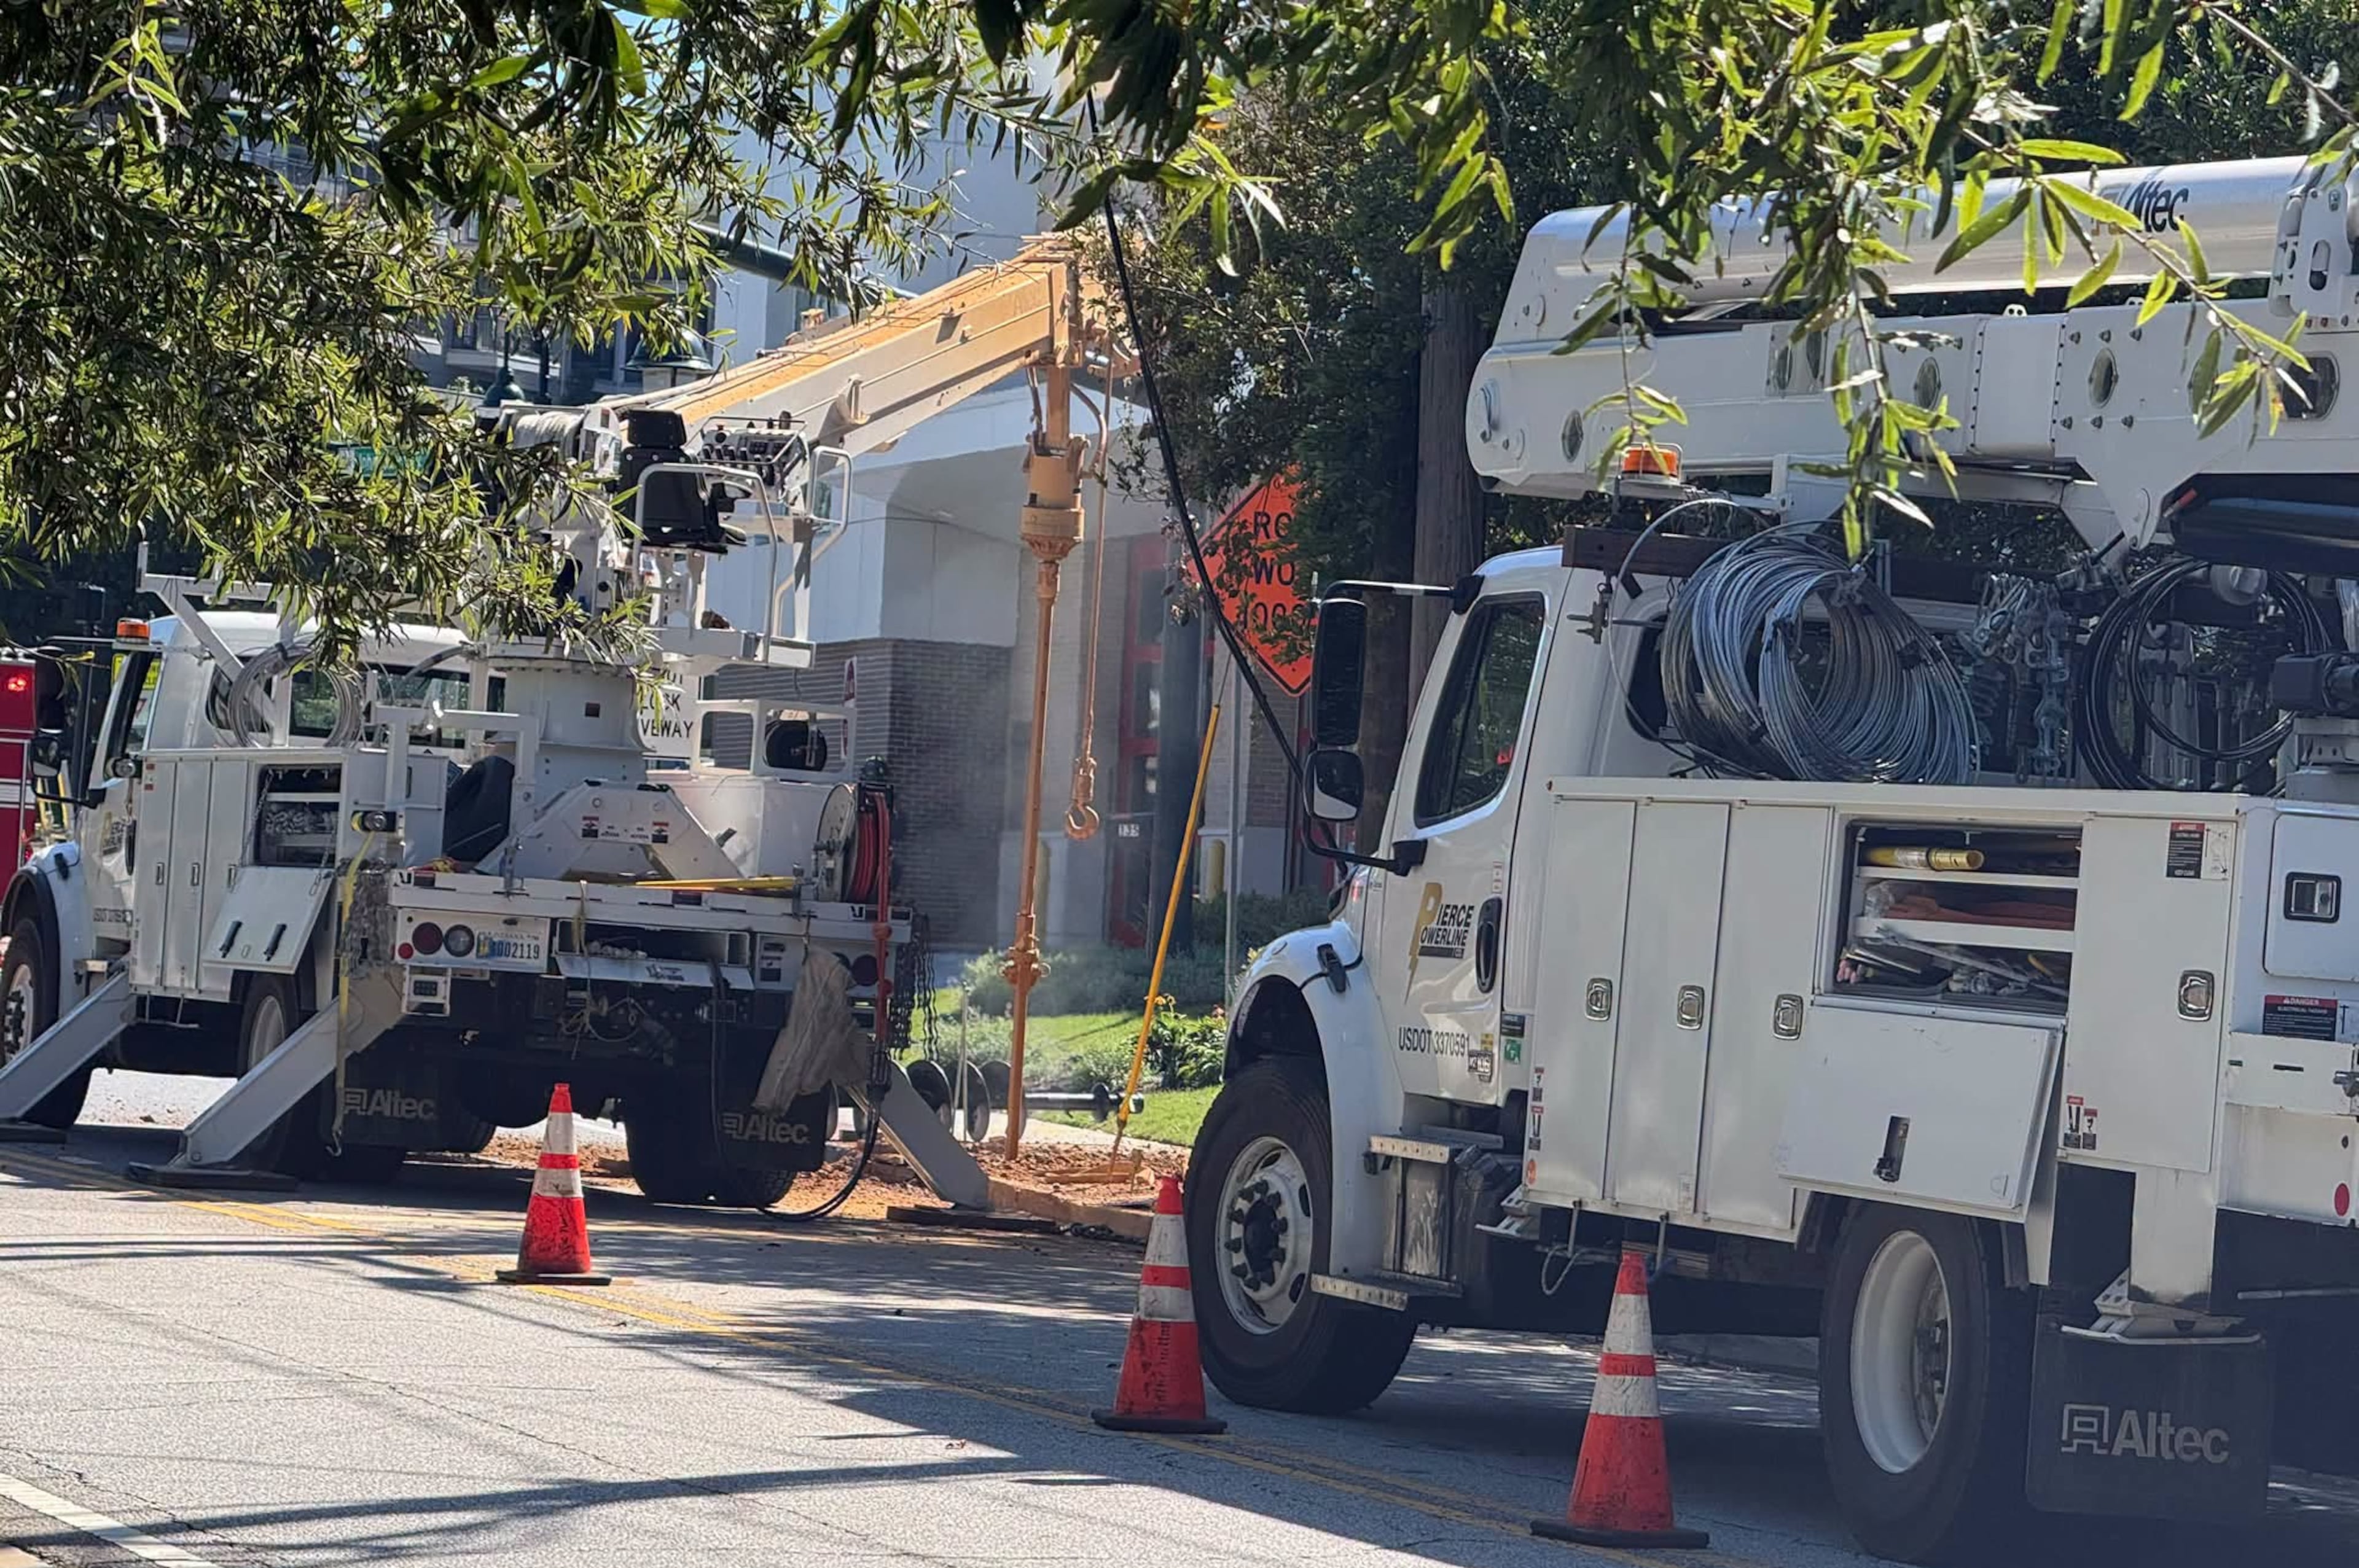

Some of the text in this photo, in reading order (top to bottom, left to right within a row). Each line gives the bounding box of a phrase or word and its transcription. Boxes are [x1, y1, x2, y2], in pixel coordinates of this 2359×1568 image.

[1253, 511, 1293, 540] RO
[1253, 556, 1296, 586] WO
[641, 718, 694, 738] VEWAY
[1399, 1026, 1433, 1054] USDOT
[1433, 1030, 1470, 1057] 3370591
[367, 1088, 436, 1119] Altec
[746, 1115, 810, 1144] Altec
[2111, 1410, 2229, 1464] Altec
